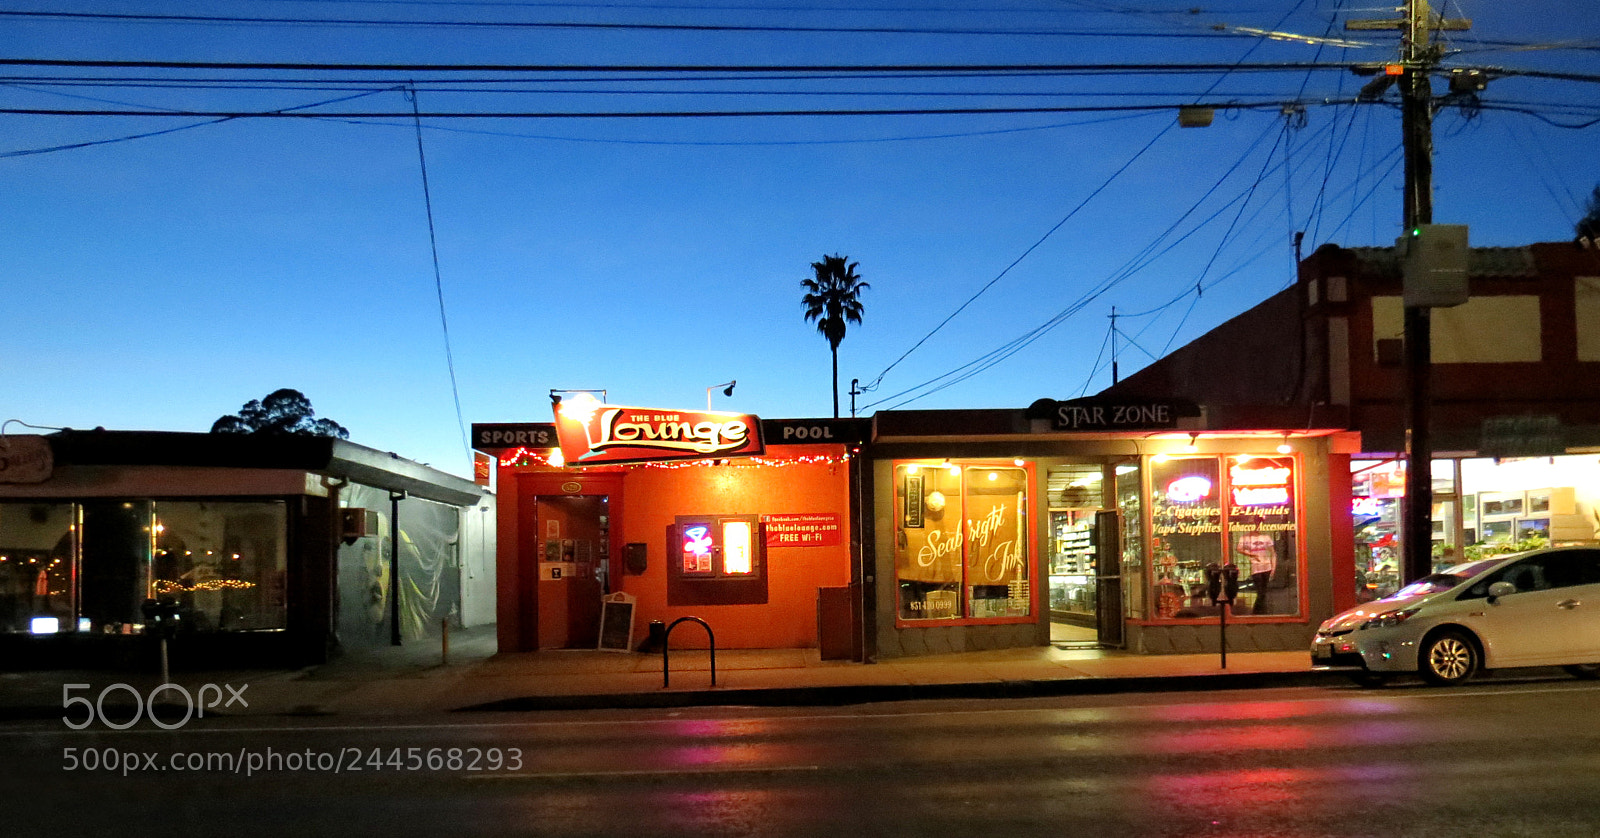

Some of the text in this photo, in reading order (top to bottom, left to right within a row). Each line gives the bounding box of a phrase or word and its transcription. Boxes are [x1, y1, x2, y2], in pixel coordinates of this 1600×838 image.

[630, 414, 679, 422] THE BLUE
[1058, 405, 1170, 428] STAR ZONE
[481, 430, 549, 445] SPORTS
[589, 408, 748, 454] Lounge
[783, 426, 834, 440] POOL
[1154, 505, 1221, 519] E-Cigarettes
[1230, 505, 1290, 517] E-Liquids
[766, 524, 838, 533] thebluelounge.com
[1178, 522, 1222, 535] Supplies
[1228, 521, 1296, 531] Tobacco Accessories
[780, 533, 822, 541] FREE Wi-Fi
[984, 540, 1024, 582] Ink
